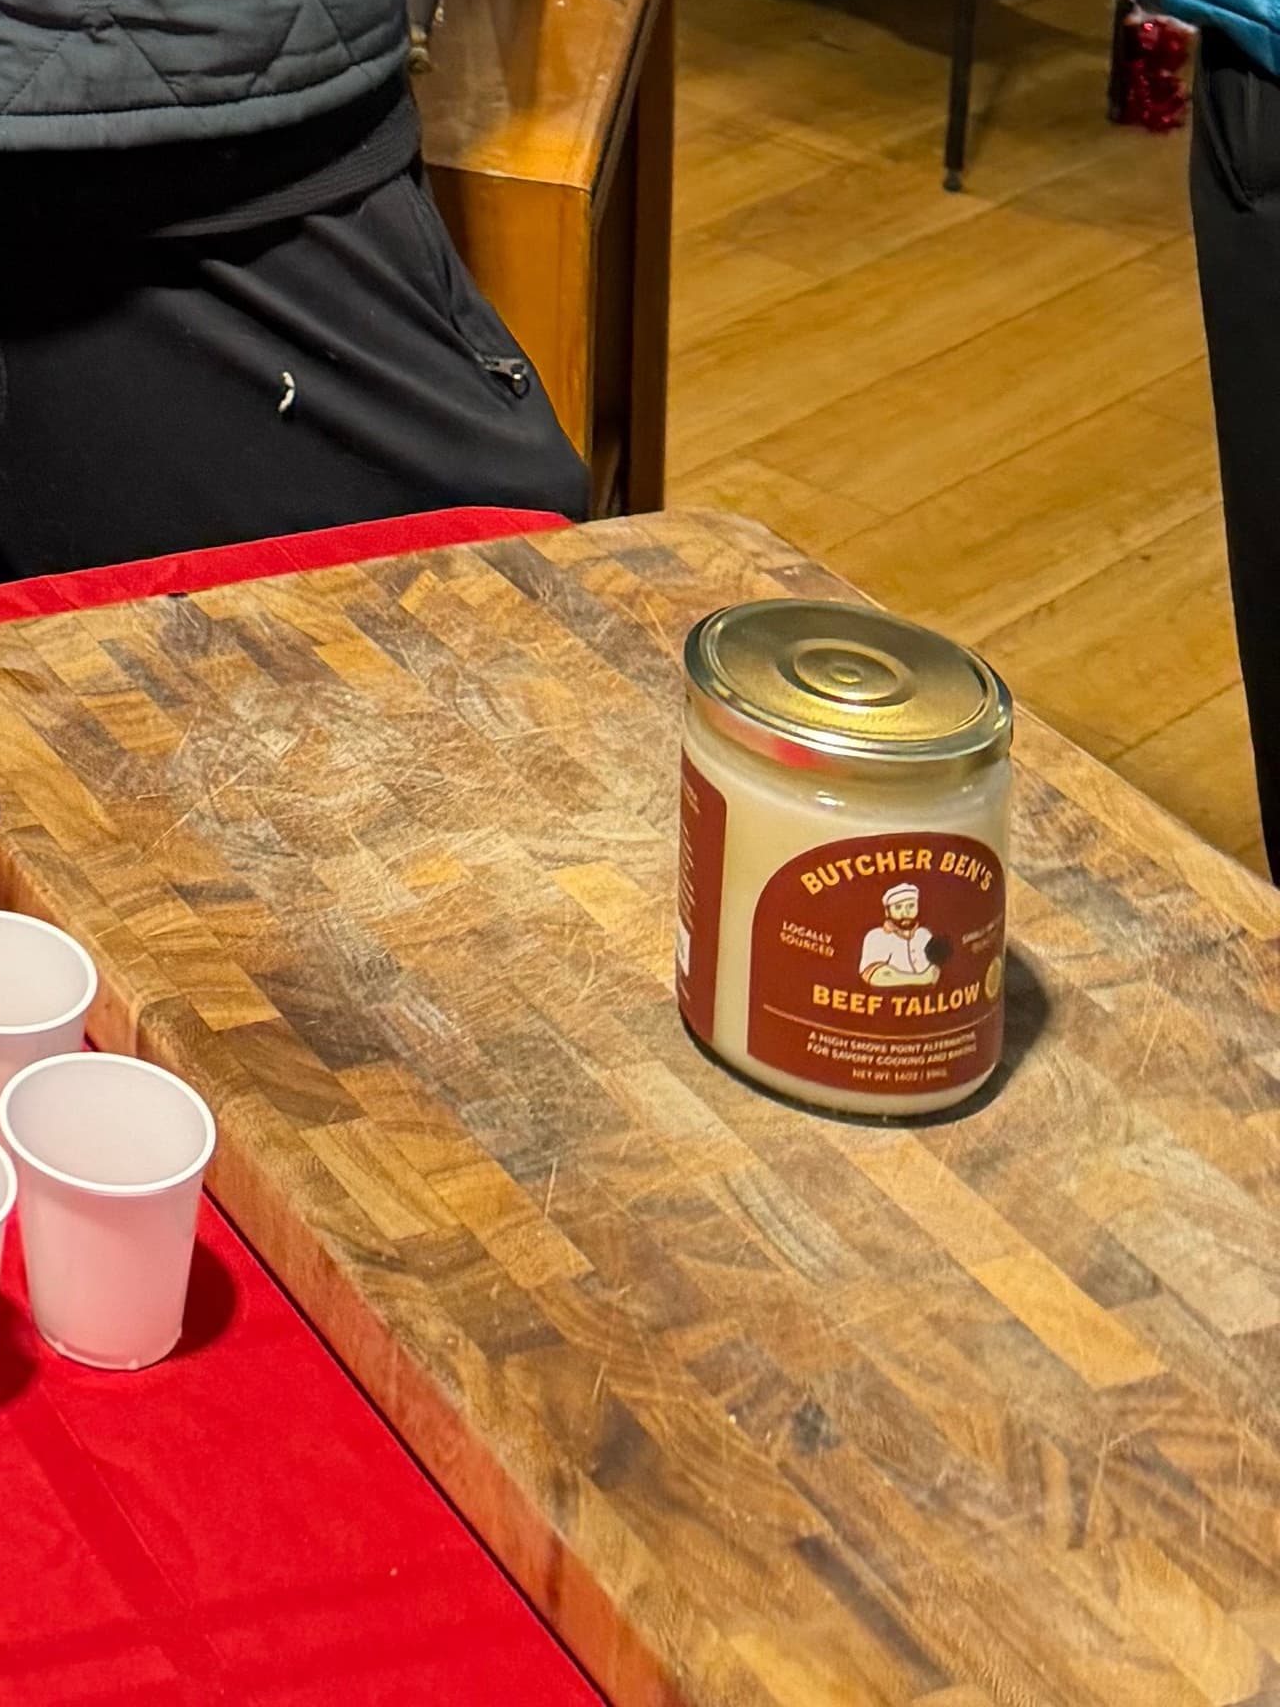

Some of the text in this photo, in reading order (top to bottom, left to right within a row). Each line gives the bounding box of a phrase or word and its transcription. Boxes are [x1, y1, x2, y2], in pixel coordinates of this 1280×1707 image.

[800, 849, 993, 897] BUTCHER BEN'S
[812, 979, 980, 1016] BEEF TALLOW
